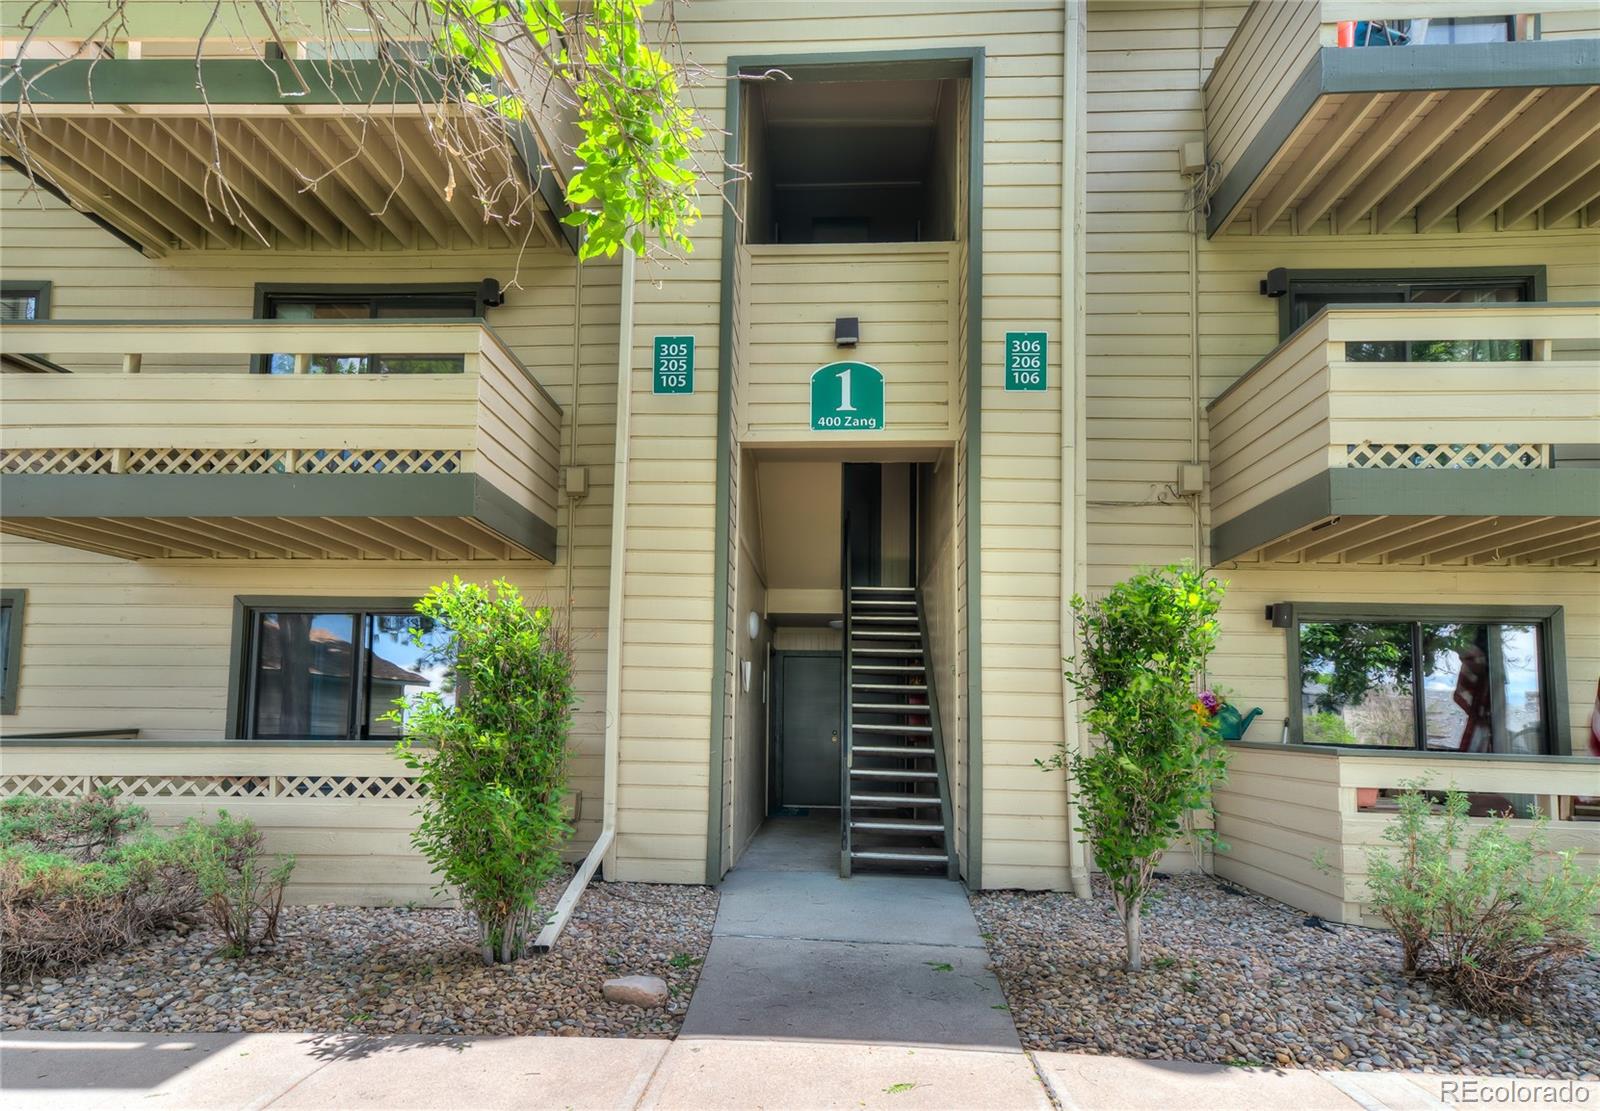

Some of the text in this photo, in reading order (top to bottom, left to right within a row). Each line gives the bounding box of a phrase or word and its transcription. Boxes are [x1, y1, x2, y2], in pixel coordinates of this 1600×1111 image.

[660, 344, 687, 356] 305
[1012, 340, 1041, 352] 306
[659, 359, 687, 371] 205
[1011, 356, 1041, 368] 206
[660, 375, 687, 387] 105
[1013, 372, 1040, 384] 106
[835, 368, 857, 411] 1
[817, 416, 877, 429] 400 Zang
